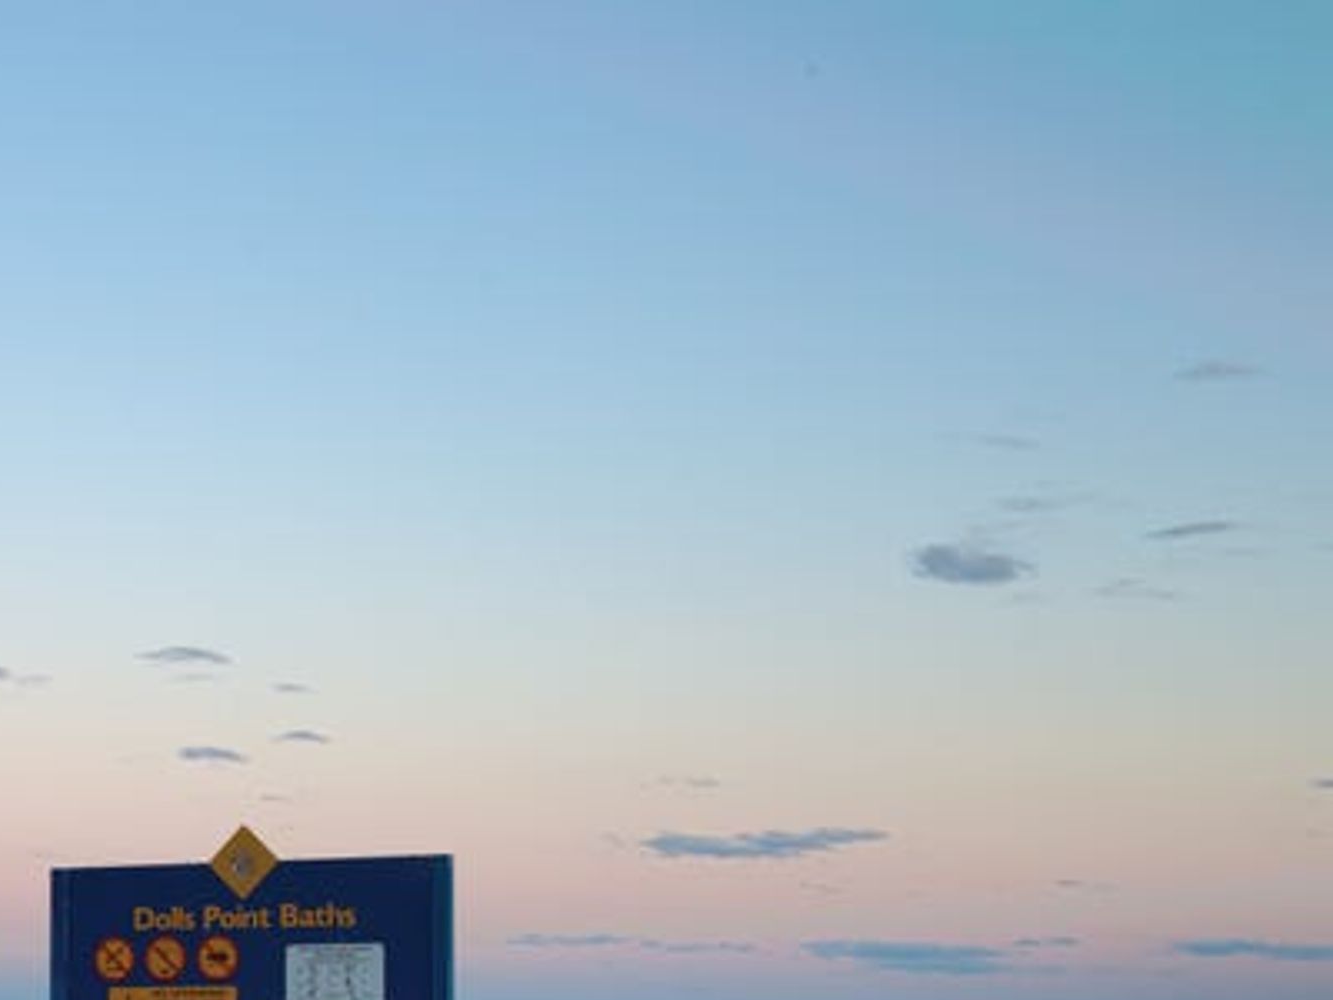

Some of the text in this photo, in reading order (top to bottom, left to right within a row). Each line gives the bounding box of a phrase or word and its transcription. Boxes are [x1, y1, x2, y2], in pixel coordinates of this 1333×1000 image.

[132, 902, 356, 932] Dolls Point Baths
